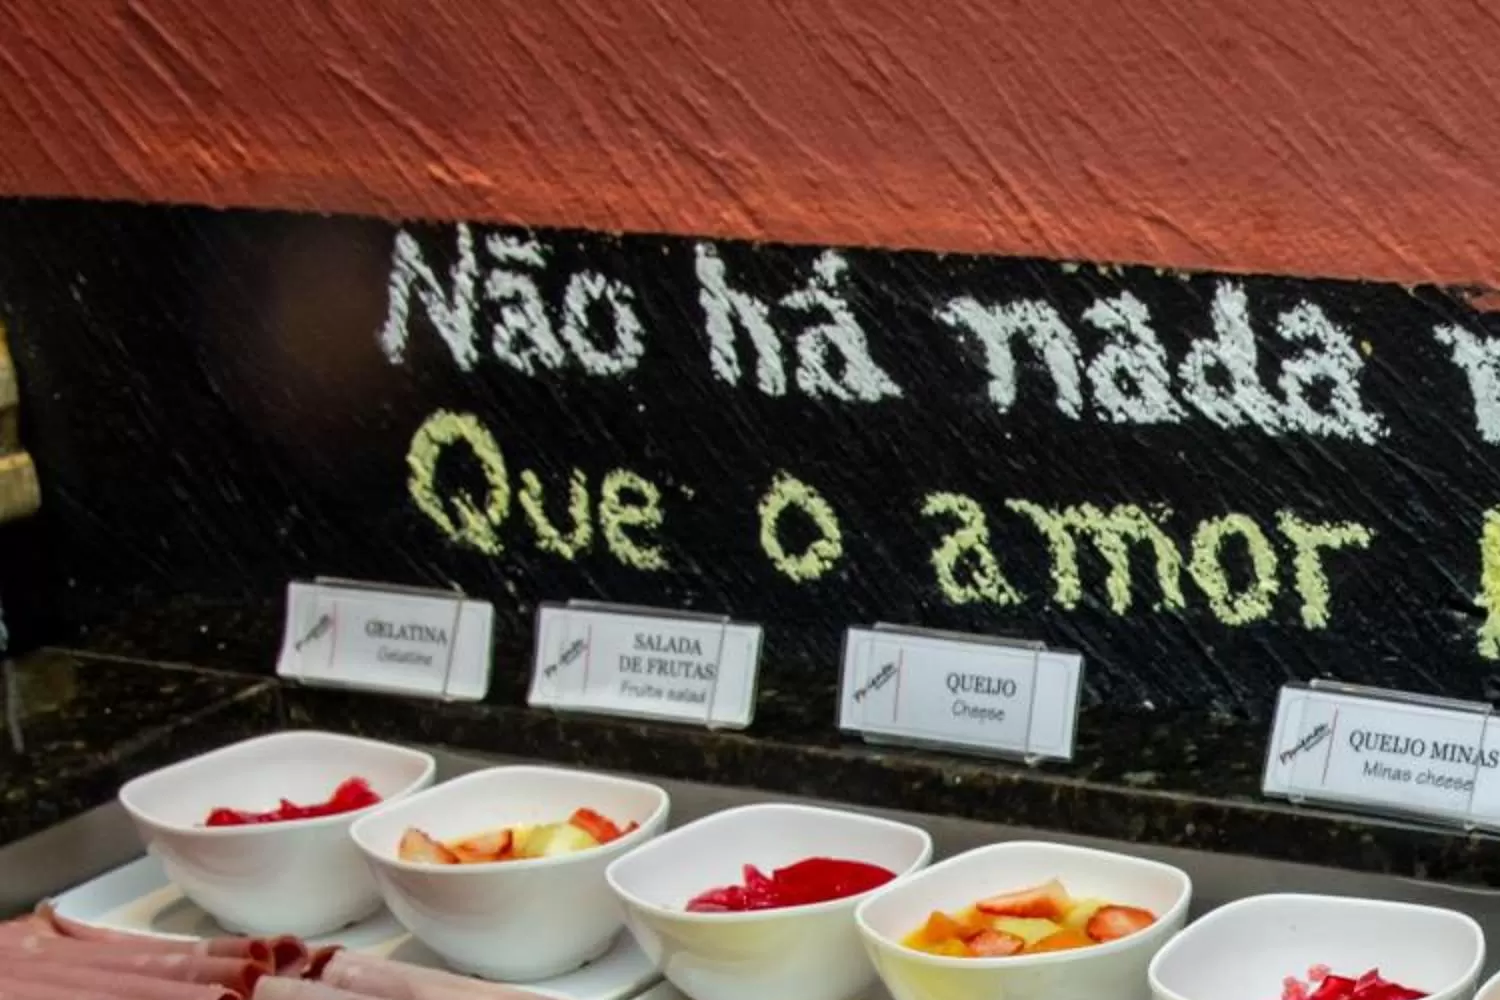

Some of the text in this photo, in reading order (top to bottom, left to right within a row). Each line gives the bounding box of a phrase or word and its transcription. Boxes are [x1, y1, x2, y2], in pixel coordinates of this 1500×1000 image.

[380, 222, 646, 377] Não
[695, 242, 902, 402] há
[932, 278, 1390, 446] nada
[405, 408, 668, 571] Que
[758, 468, 843, 582] o
[920, 491, 1376, 630] amor
[364, 619, 449, 646] GELATINA
[632, 632, 703, 656] SALADA
[619, 655, 717, 681] DE FRUTAS
[666, 686, 707, 703] salad
[946, 671, 1017, 698] QUEIJO
[951, 699, 1006, 723] Cheese
[1349, 729, 1427, 757] QUEIJO
[1430, 740, 1500, 769] MINAS
[1362, 761, 1475, 792] Minas cheese
